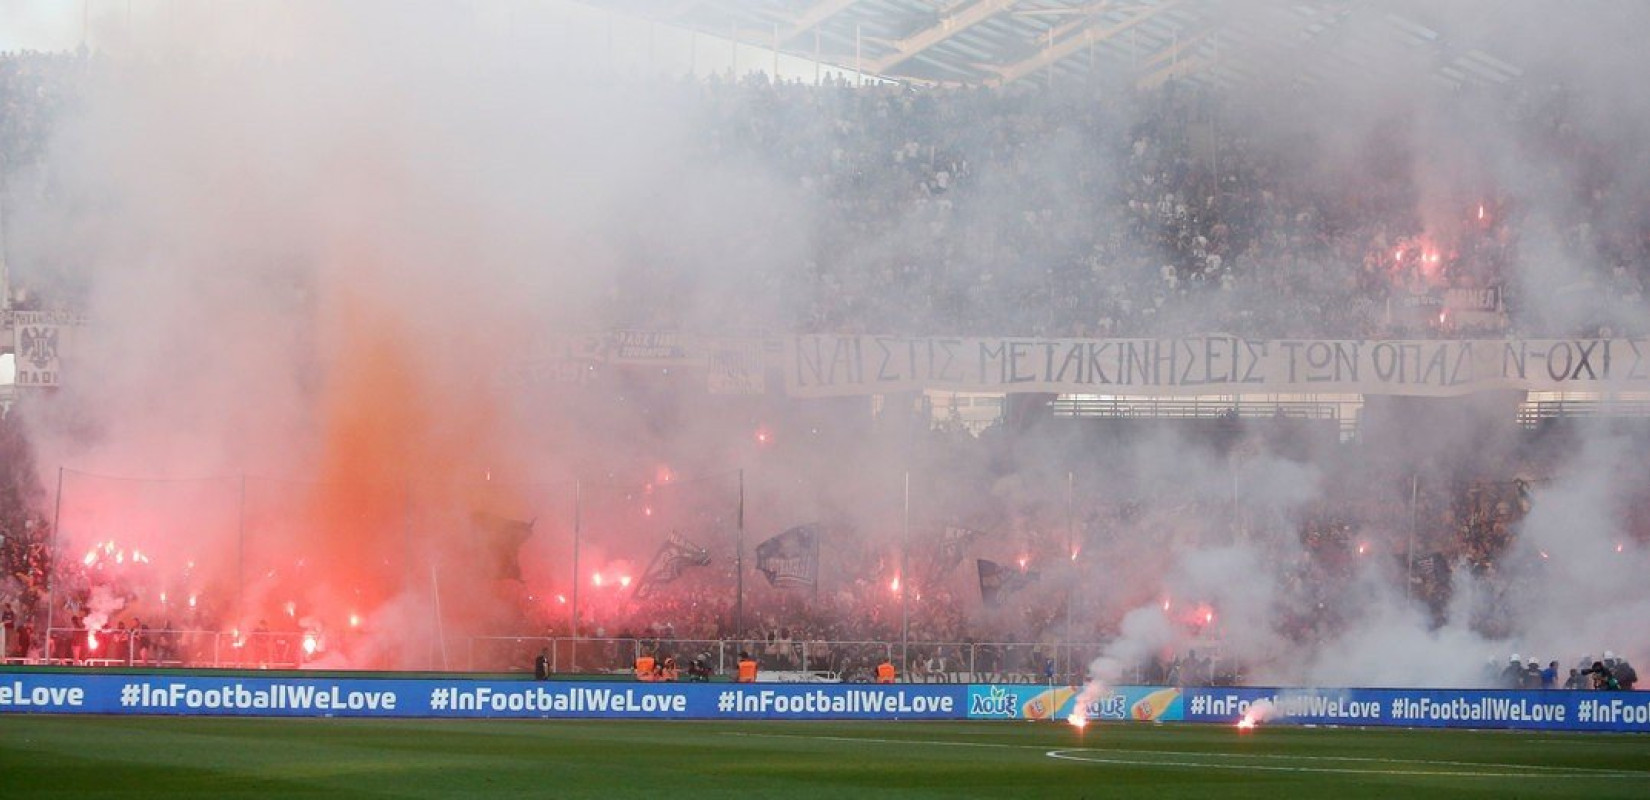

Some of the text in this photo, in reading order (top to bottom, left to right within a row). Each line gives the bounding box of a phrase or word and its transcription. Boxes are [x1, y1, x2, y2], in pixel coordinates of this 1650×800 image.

[796, 336, 864, 387] ΝΑΙ
[874, 336, 965, 382] ΣΤΙΣ
[979, 337, 1268, 386] ΜΕΤΑΚΙΝΗΣΕΙΣ
[1280, 341, 1359, 384] ΤΩΝ
[120, 683, 397, 711] #InFootballWeLove
[430, 687, 687, 714] #InFootballWeLove
[718, 690, 953, 717] #InFootballWeLove
[1190, 694, 1650, 724] #InFoallWeLove #InFootballWeLove #InFoo
